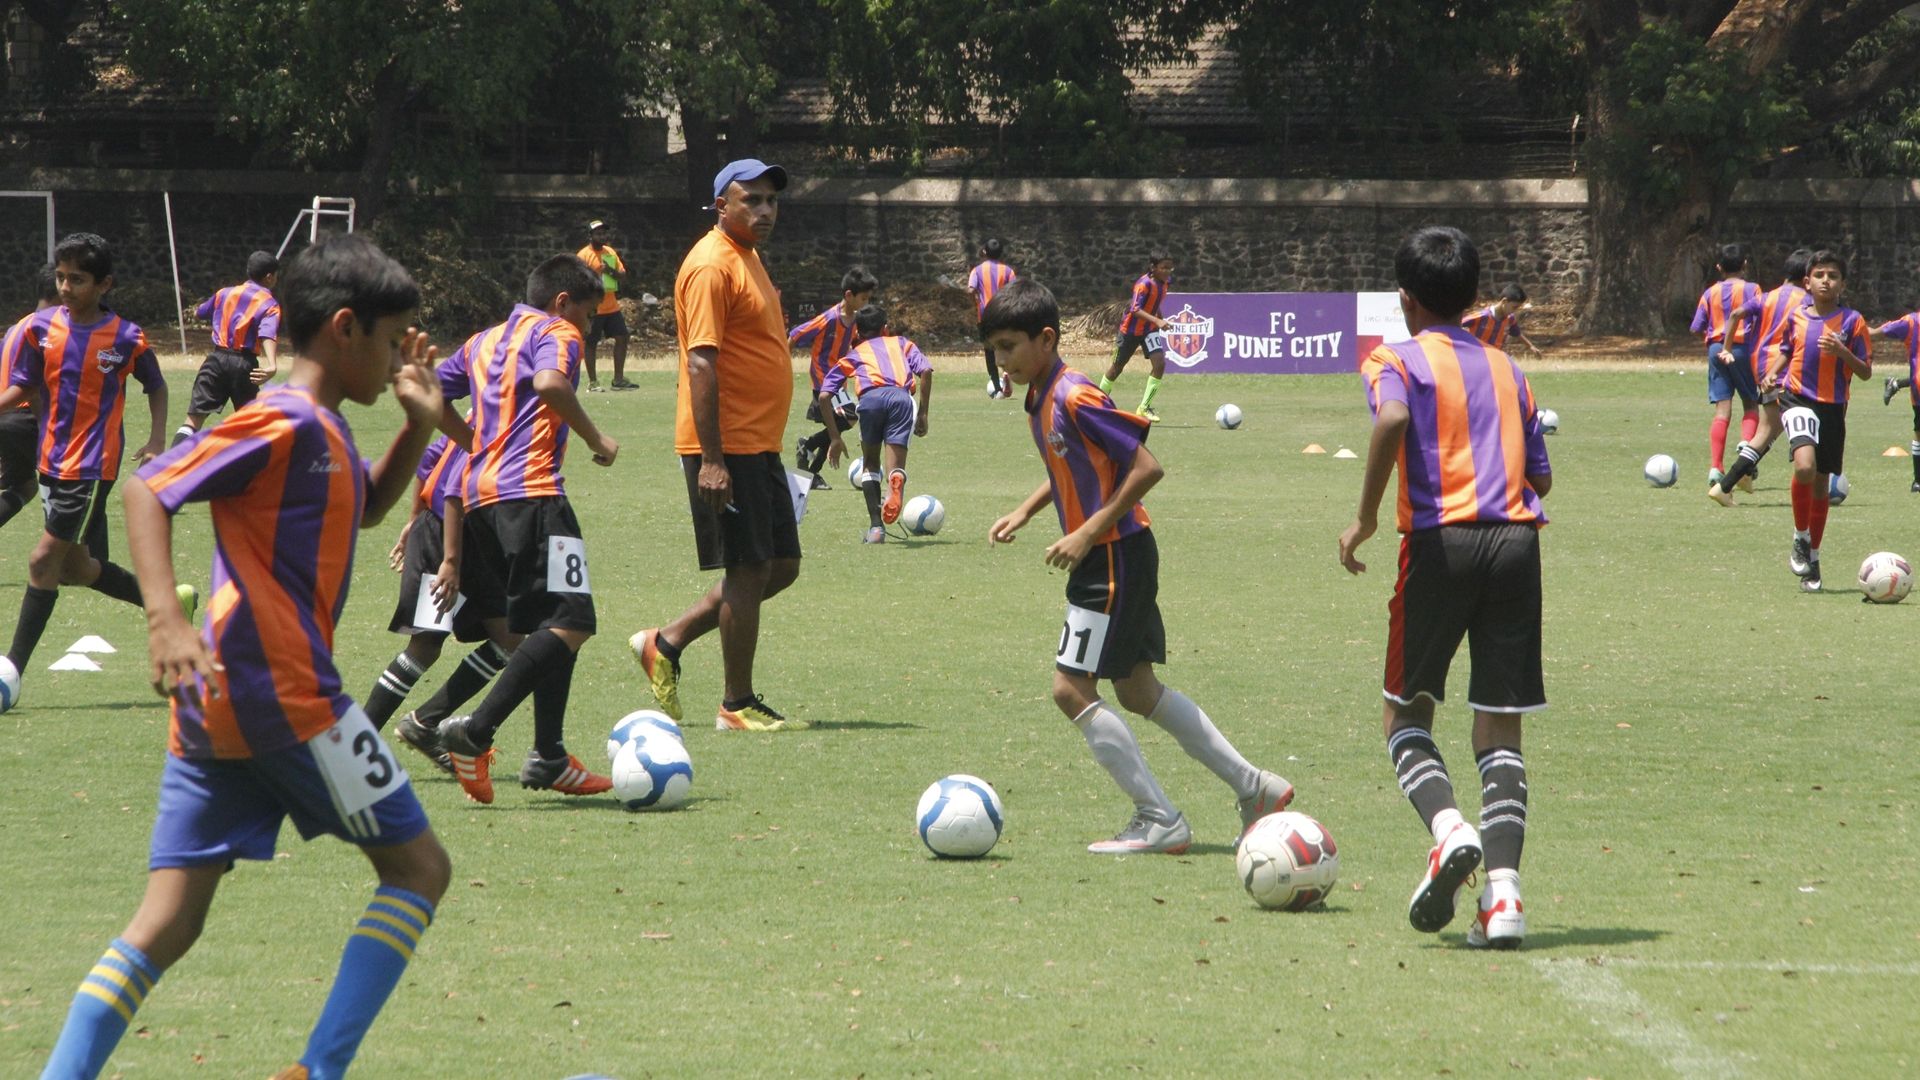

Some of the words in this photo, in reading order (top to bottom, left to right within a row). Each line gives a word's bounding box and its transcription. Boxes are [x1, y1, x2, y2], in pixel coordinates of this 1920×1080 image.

[1189, 322, 1210, 333] CITY
[1270, 312, 1296, 334] FC
[1223, 332, 1283, 358] PUNE
[1290, 331, 1342, 358] CITY
[1785, 415, 1816, 438] 100
[565, 553, 583, 588] 8
[352, 729, 394, 789] 3
